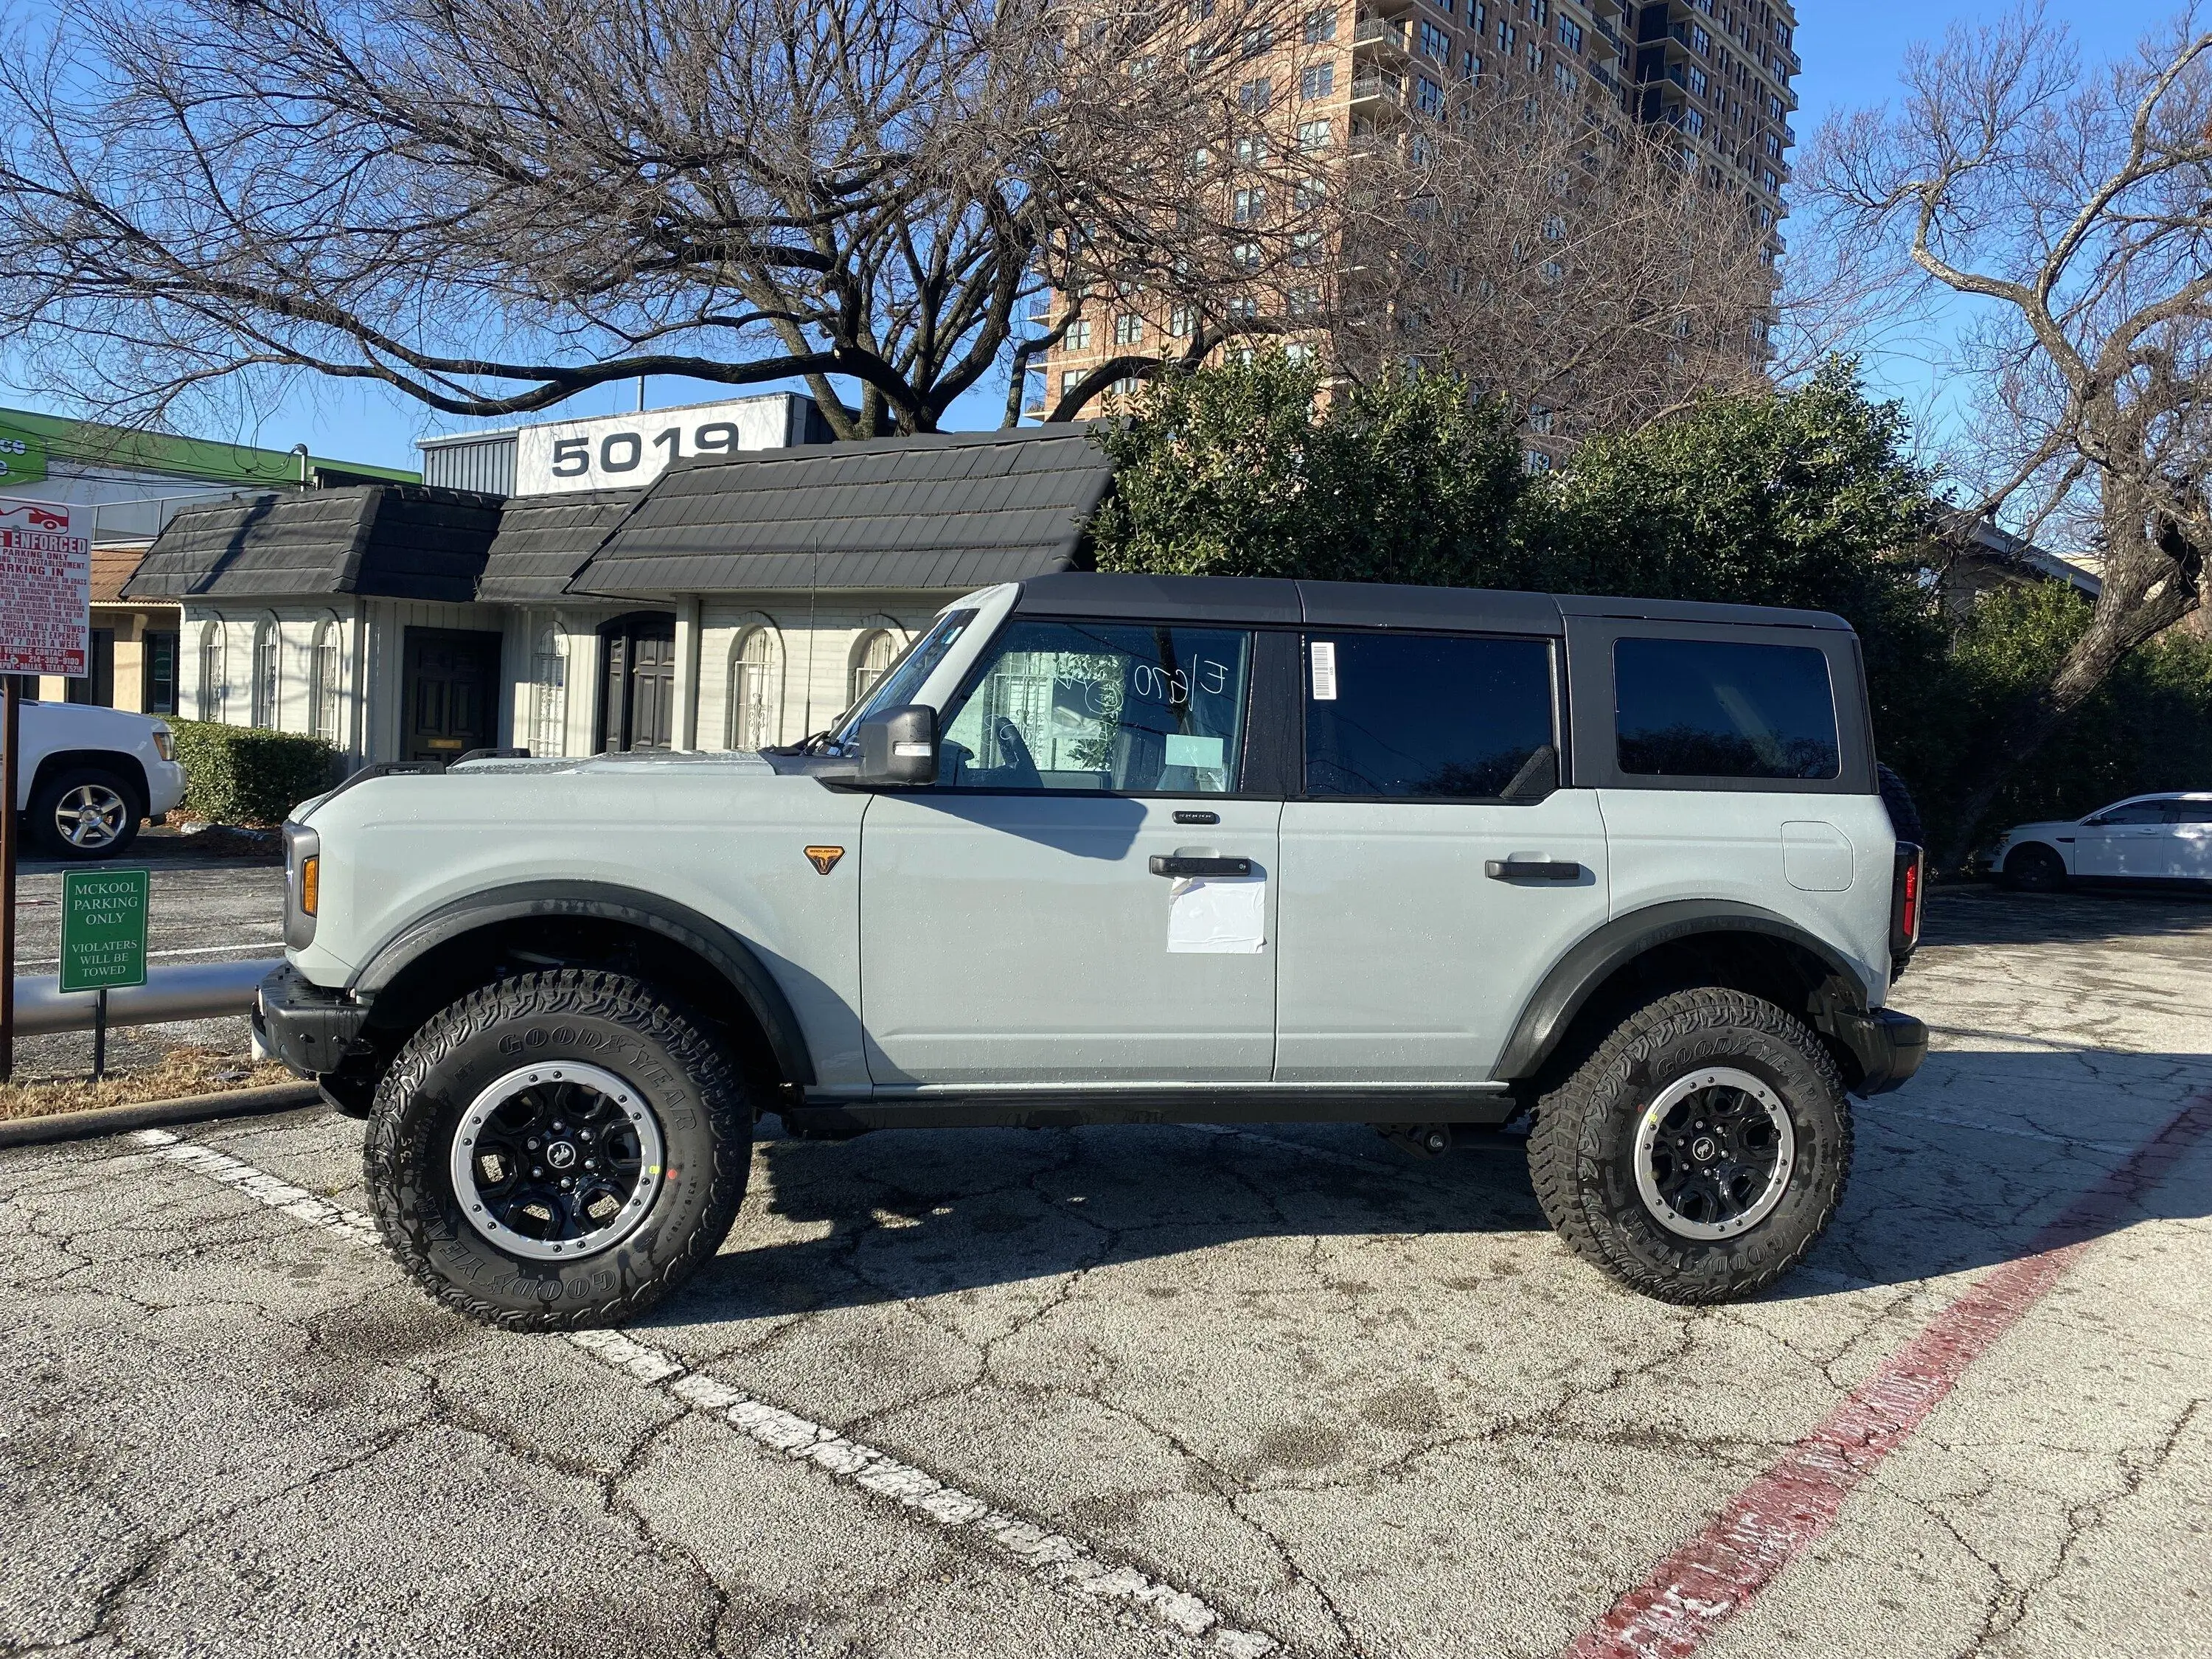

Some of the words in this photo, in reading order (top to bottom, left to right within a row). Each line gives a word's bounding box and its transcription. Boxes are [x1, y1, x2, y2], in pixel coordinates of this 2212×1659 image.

[552, 422, 739, 477] 5019
[11, 532, 86, 554] ENFORCED
[3, 549, 42, 559] PARKING
[46, 552, 69, 560] ONLY
[14, 557, 29, 565] THIS
[52, 567, 64, 577] IN
[38, 582, 59, 590] PARKING
[18, 588, 52, 597] OBSTRUCTING
[52, 597, 82, 605] INOPERABLE
[63, 605, 85, 613] BACKING
[2, 613, 25, 622] WHEELER
[4, 628, 46, 639] OPERATOR'S
[32, 623, 48, 632] WILL
[51, 624, 60, 632] BE
[63, 625, 86, 633] TOWED
[27, 638, 46, 647] DAYS
[59, 640, 80, 649] WEEK
[4, 646, 32, 655] VEHICLE
[46, 664, 64, 672] TEXAS
[74, 882, 139, 896] MCKOOL
[74, 897, 138, 911] PARKING
[86, 912, 126, 925] ONLY
[72, 940, 137, 953] VIOLATERS
[80, 954, 110, 965] WILL
[114, 953, 129, 962] BE
[82, 965, 126, 978] TOWED
